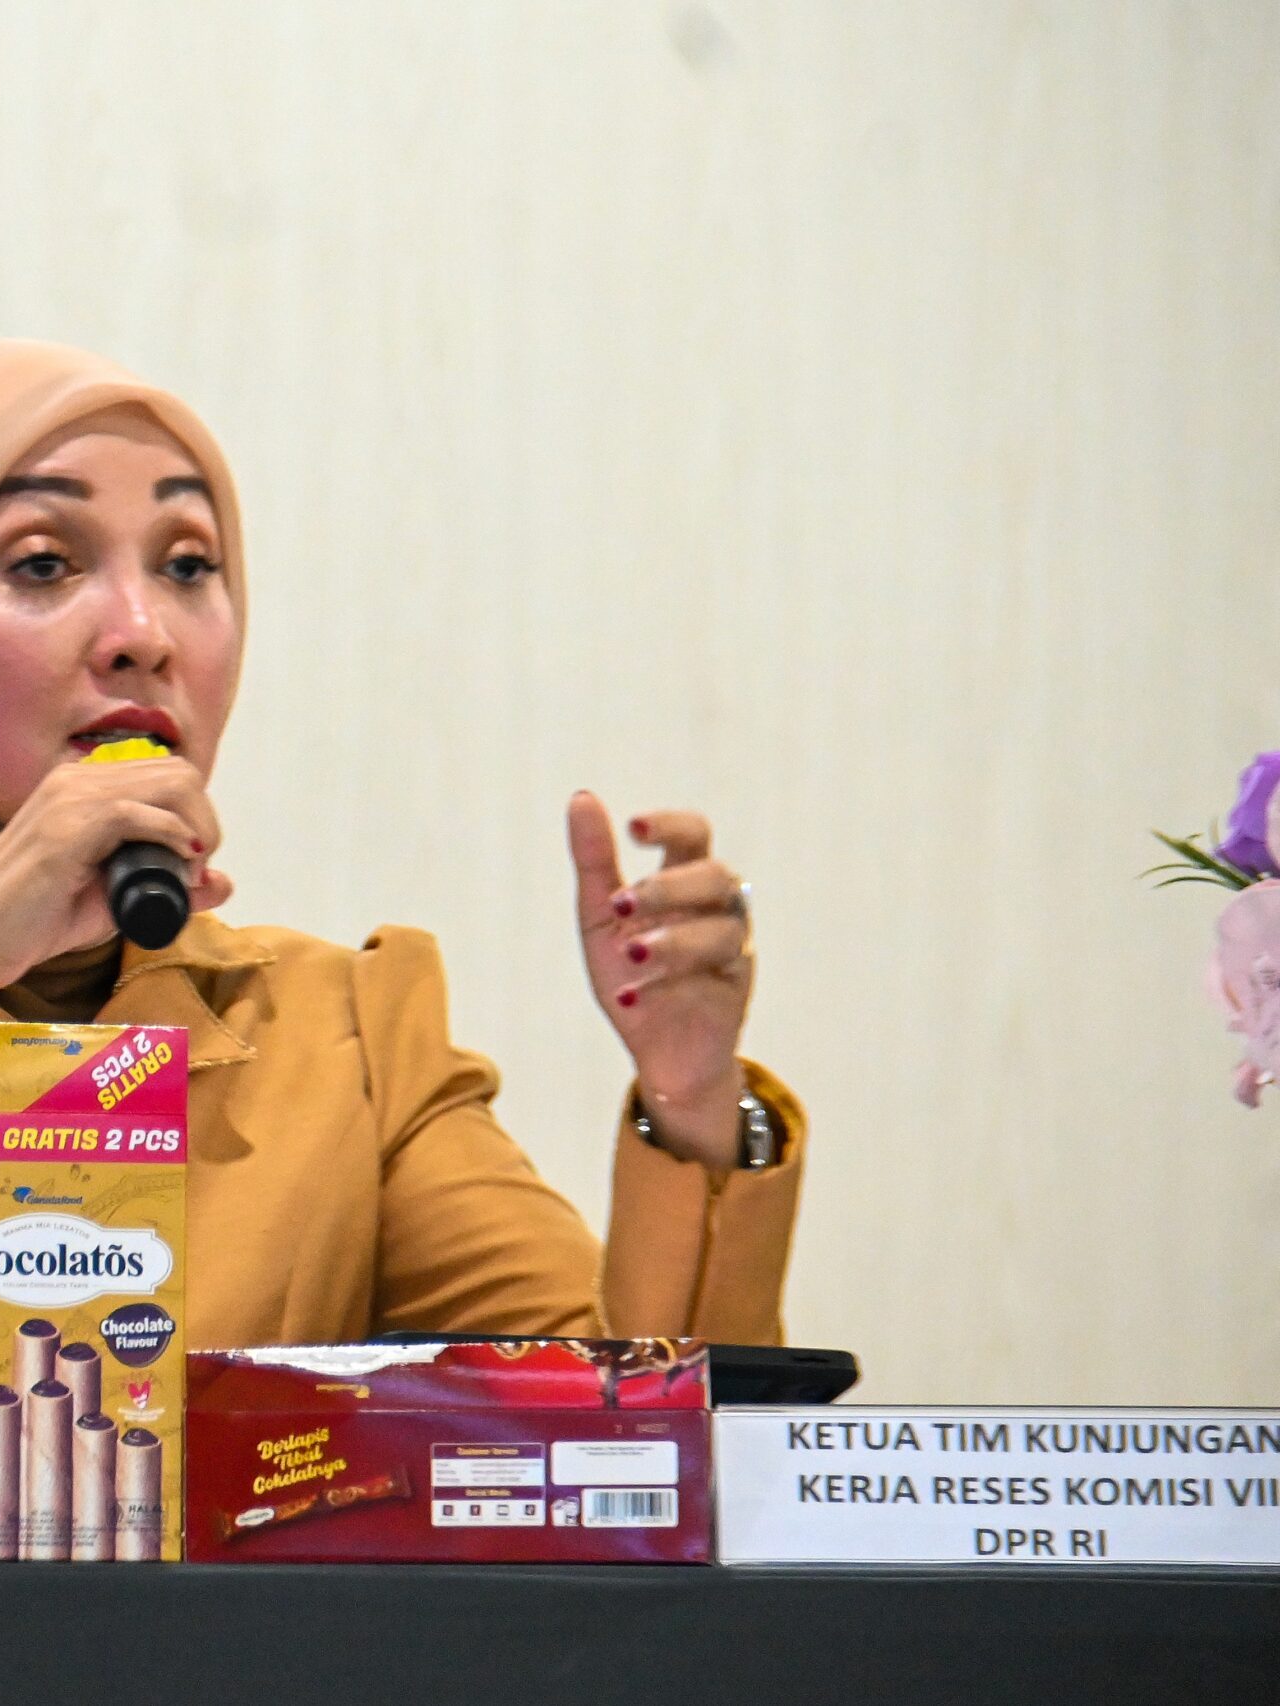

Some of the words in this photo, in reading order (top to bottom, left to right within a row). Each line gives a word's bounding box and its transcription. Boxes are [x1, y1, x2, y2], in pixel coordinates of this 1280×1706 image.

[132, 1031, 151, 1054] 2
[91, 1044, 135, 1088] PCS
[97, 1041, 173, 1111] GRATIS
[3, 1128, 99, 1150] GRATIS
[104, 1129, 122, 1151] 2
[128, 1129, 180, 1152] PCS
[101, 1317, 173, 1336] Chocolate
[115, 1336, 159, 1350] Flavour
[257, 1427, 330, 1460] Berlapis
[789, 1422, 920, 1451] KETUA
[933, 1423, 1009, 1452] TIM
[1025, 1424, 1280, 1454] KUNJUNGAN
[799, 1474, 918, 1504] KERJA
[934, 1476, 1050, 1505] RESES
[1065, 1477, 1212, 1507] KOMISI
[1225, 1478, 1279, 1507] VII
[975, 1528, 1055, 1556] DPR
[1069, 1529, 1105, 1557] RI
